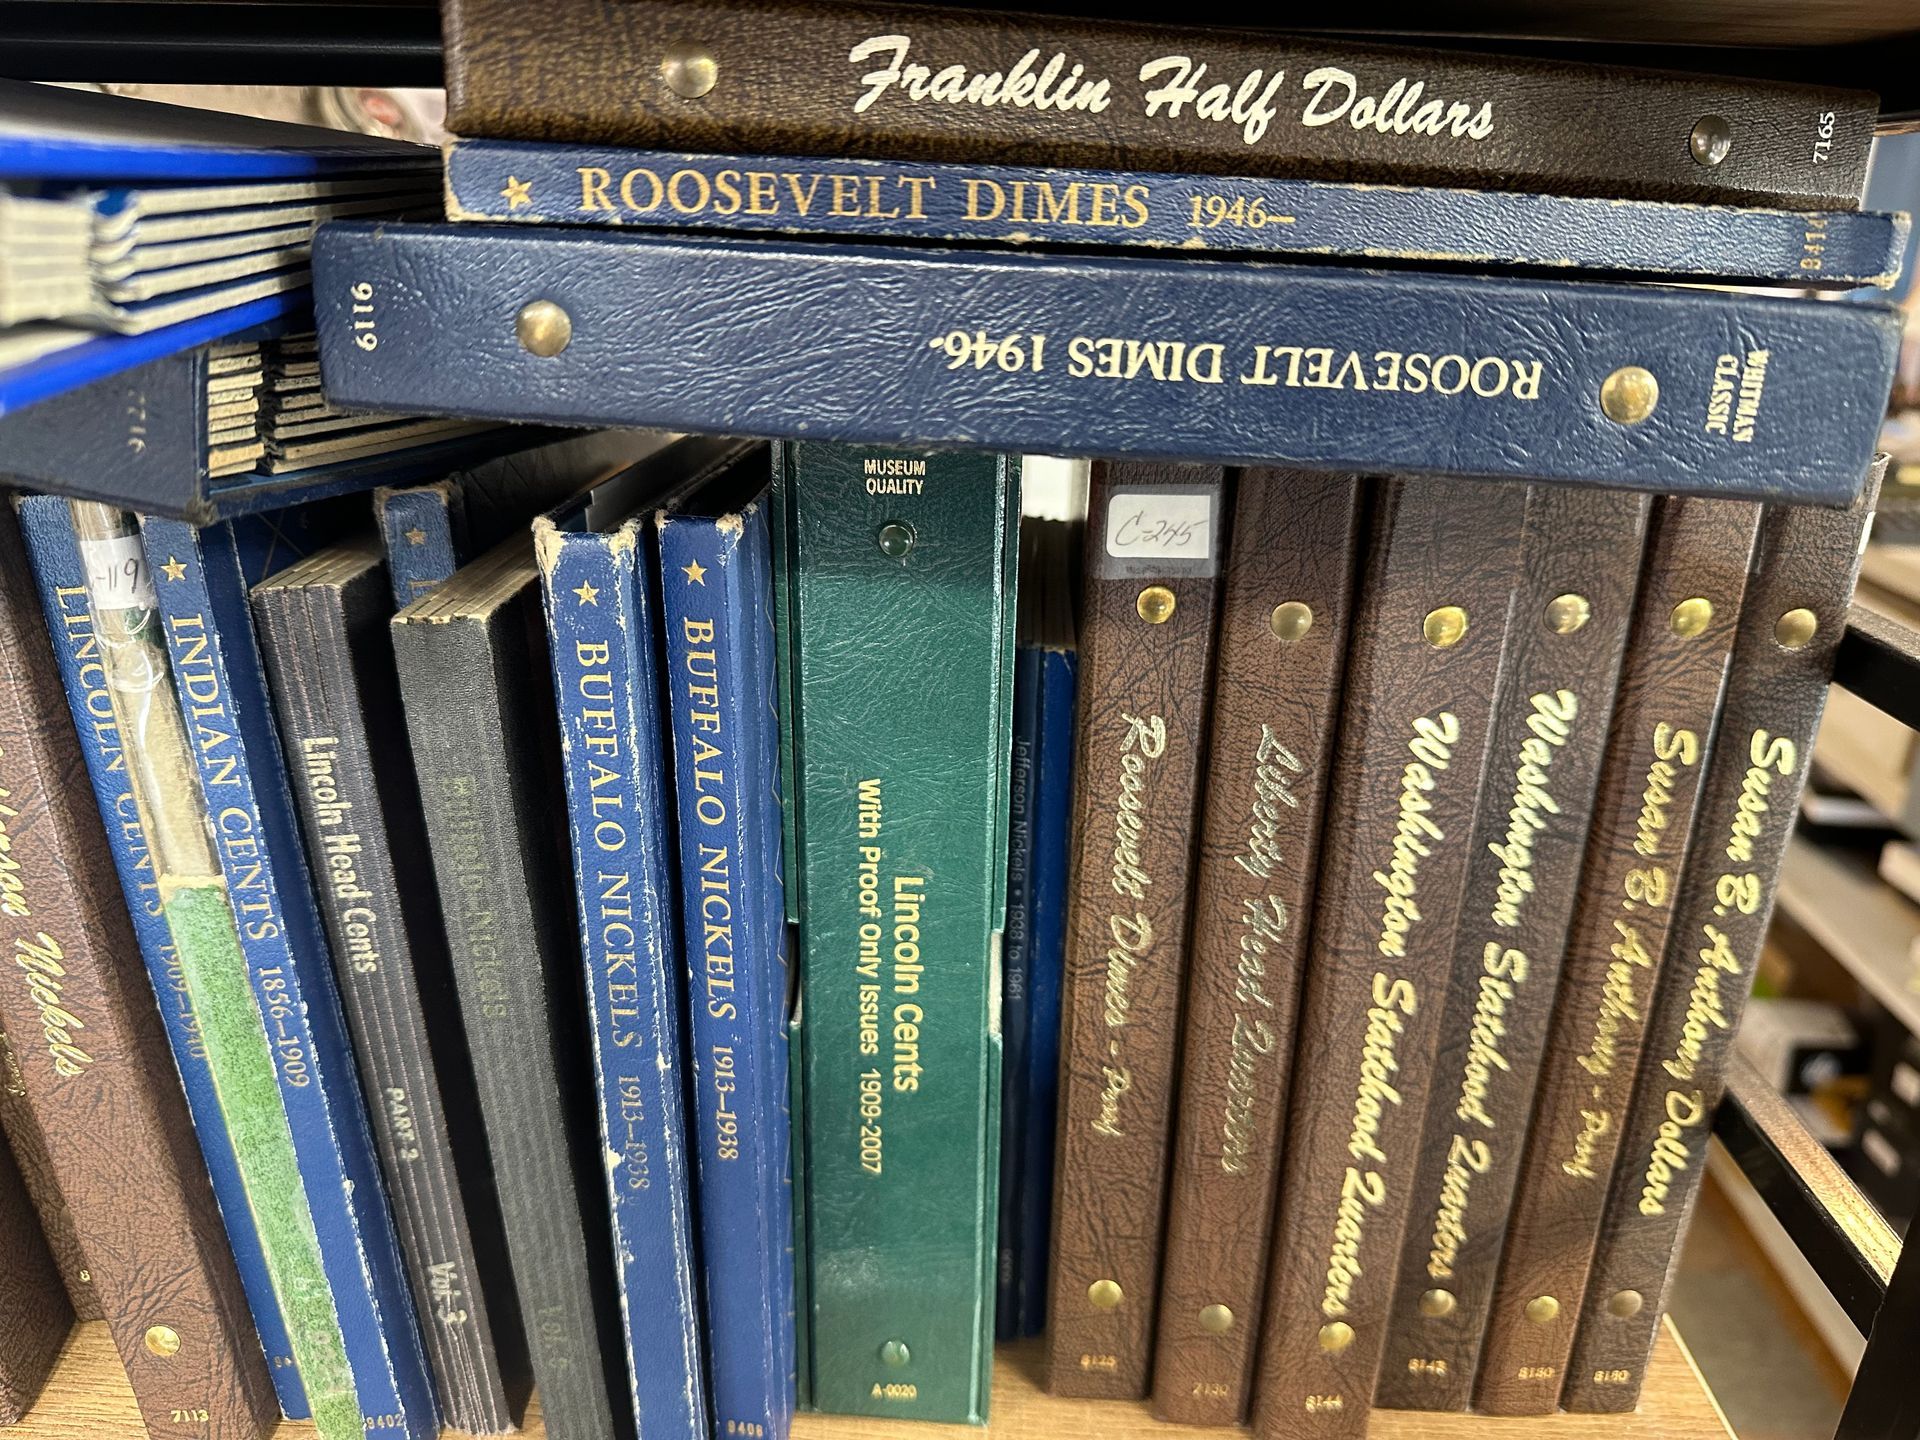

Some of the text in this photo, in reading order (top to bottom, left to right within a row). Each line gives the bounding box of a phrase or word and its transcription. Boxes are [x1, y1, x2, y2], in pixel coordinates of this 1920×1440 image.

[849, 35, 1494, 145] Franklin Half Dollars
[1812, 111, 1836, 165] 7165
[577, 166, 936, 222] ROOSEVELT
[960, 177, 1150, 229] DIMES
[350, 281, 378, 352] 9119
[1067, 337, 1225, 385] DIMES
[1240, 344, 1543, 401] ROOSEVELT
[1705, 354, 1739, 435] CLASSIC
[1732, 349, 1769, 443] WHITMAN
[864, 459, 926, 477] MUSEUM
[865, 477, 925, 497] QUALITY
[1115, 510, 1208, 547] C-245
[56, 584, 128, 773] LINCOLN
[683, 616, 728, 828] BUFFALO
[168, 611, 244, 788] INDIAN
[219, 804, 280, 943] CENTS
[576, 638, 628, 853] BUFFALO
[1012, 735, 1031, 815] Jefferson
[1233, 723, 1303, 879] Liberty
[1632, 720, 1700, 858] Susan
[302, 737, 380, 974] Lincoln Head Cents
[1010, 819, 1028, 882] Nickels
[1112, 712, 1166, 900] Roosevelt
[698, 842, 738, 1023] NICKELS
[1621, 866, 1671, 912] B.
[14, 931, 95, 1077] Nickels
[598, 871, 644, 1050] NICKELS
[856, 778, 883, 1176] With Proof Only Issues 1909-2007
[893, 875, 925, 1093] Lincoln Cents
[1007, 945, 1025, 960] to
[1104, 912, 1153, 1028] Dimes
[1235, 894, 1288, 1008] Head
[1426, 688, 1579, 1280] Washington Statehood Quarters
[1576, 919, 1655, 1079] Anthony
[1638, 729, 1798, 1218] Susan B. Anthony Dollars
[1321, 711, 1462, 1318] Washington Statehood Quarters
[384, 1087, 416, 1141] PART
[170, 1409, 209, 1424] 7113
[870, 1382, 918, 1400] A-0020
